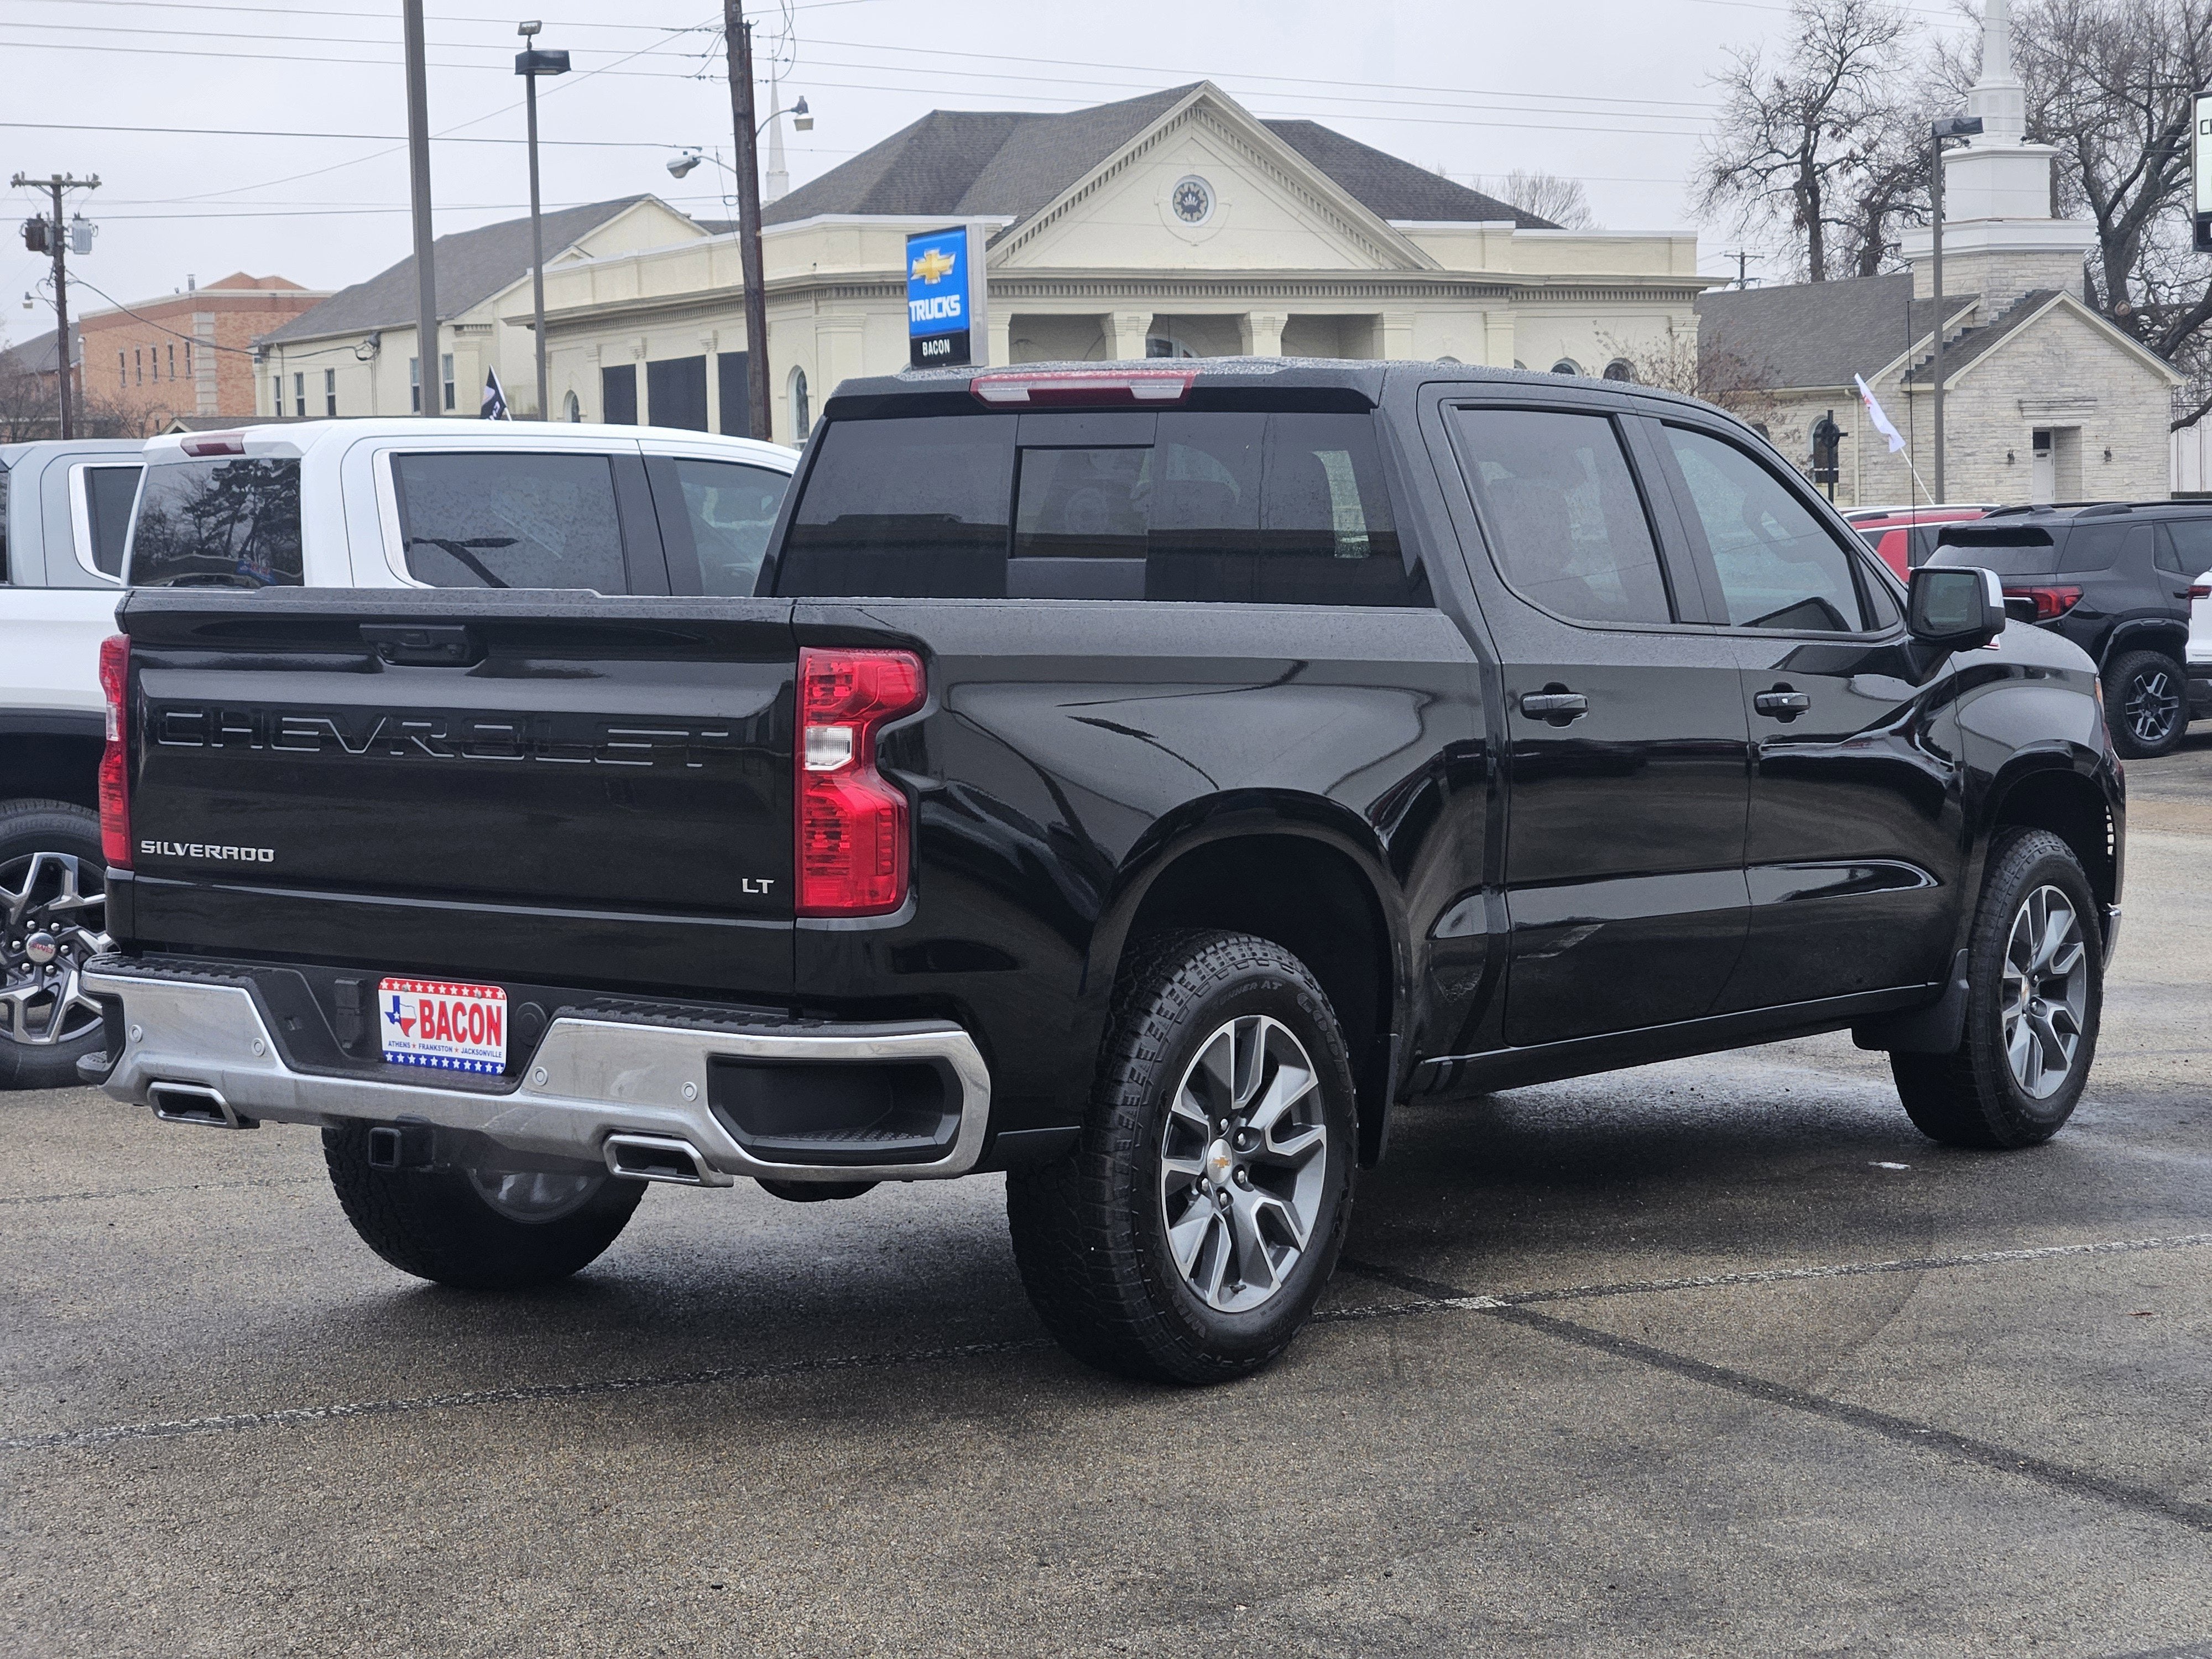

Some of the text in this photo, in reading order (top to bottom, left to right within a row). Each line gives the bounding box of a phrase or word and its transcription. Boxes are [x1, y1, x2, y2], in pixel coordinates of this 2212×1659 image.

[909, 294, 961, 322] TRUCKS
[922, 339, 951, 357] BACON
[157, 705, 729, 768] CHEVROLET
[141, 840, 275, 862] SILVERADO
[742, 878, 775, 894] LT
[419, 999, 502, 1047] BACON
[388, 1040, 502, 1058] ATHENS FRANKSTON JACKSONVILLE
